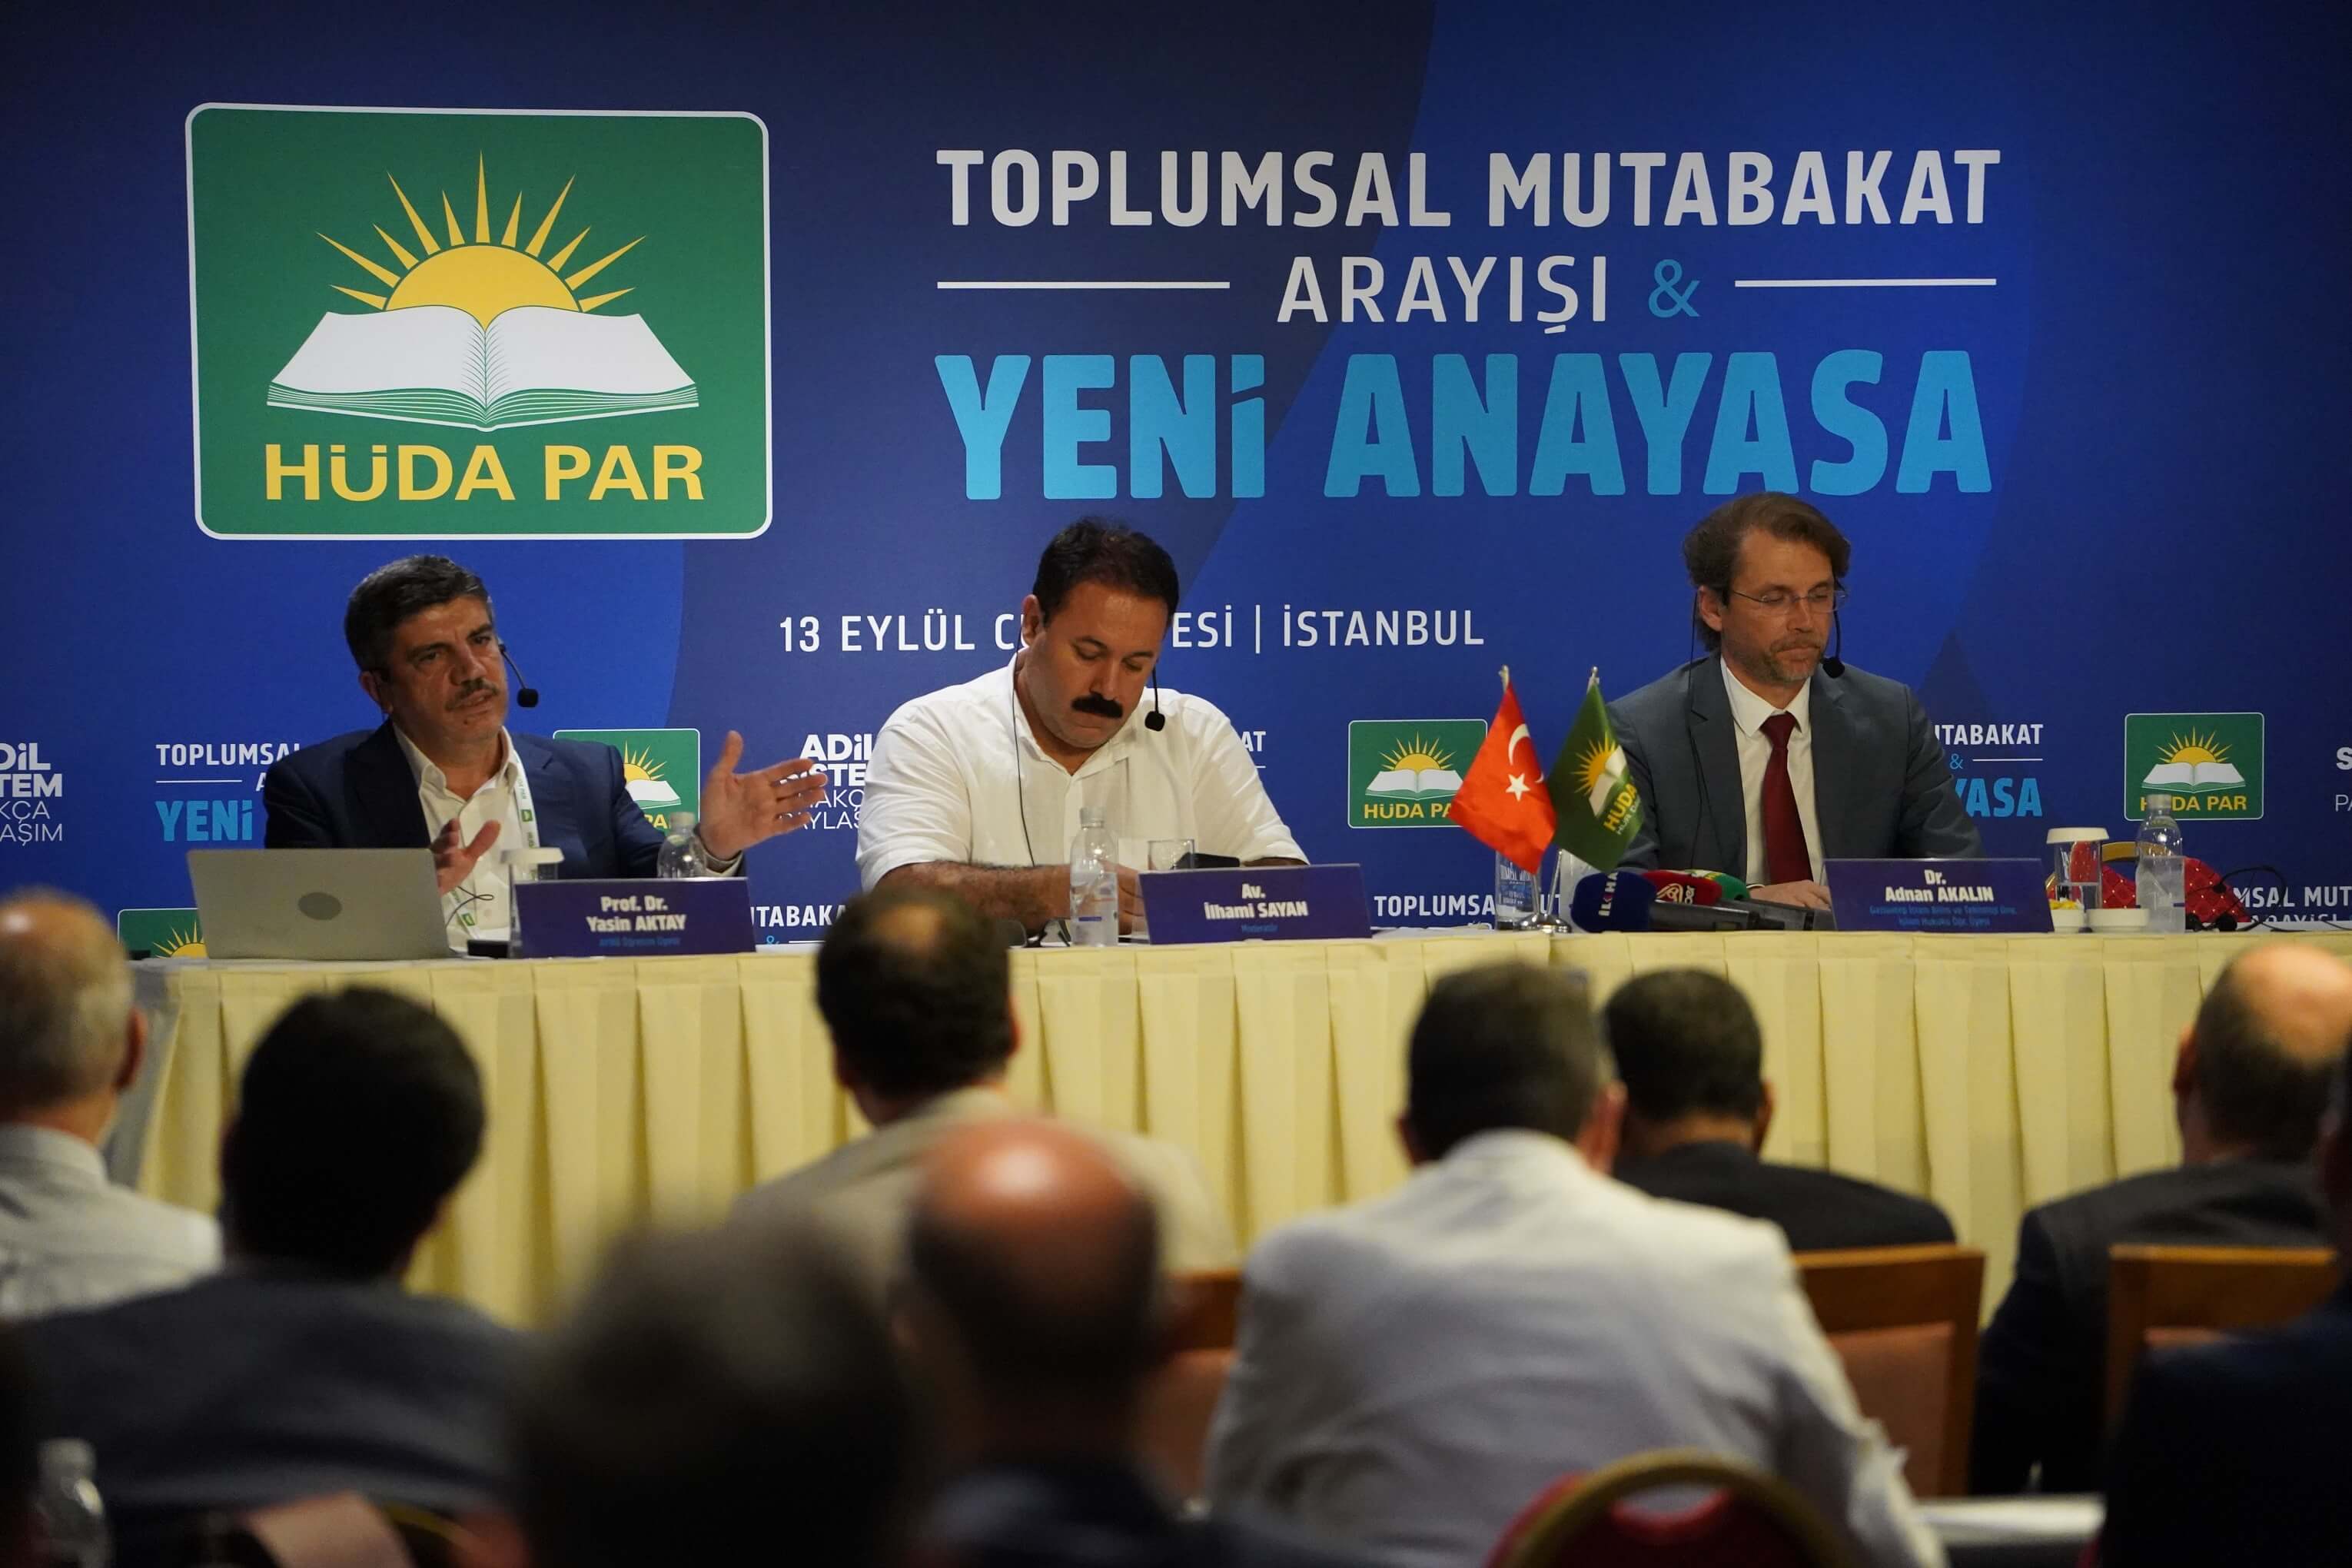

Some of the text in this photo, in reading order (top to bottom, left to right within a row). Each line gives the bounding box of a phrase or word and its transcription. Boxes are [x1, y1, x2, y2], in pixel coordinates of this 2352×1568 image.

[936, 149, 2001, 228] TOPLUMSAL MUTABAKAT
[1277, 255, 1700, 334] ARAYIŞI &
[1324, 350, 1992, 498] ANAYASA
[265, 444, 705, 502] HÜDA PAR
[779, 616, 820, 653] 13
[841, 608, 975, 652] EYLÜL
[1284, 604, 1484, 647] İSTANBUL
[1934, 724, 2044, 746] TABAKAT
[2207, 796, 2247, 811] PAR
[0, 824, 62, 846] AŞIM
[1924, 869, 1947, 885] Dr.
[1241, 883, 1266, 899] Av.
[1885, 886, 1995, 902] Adnan AKALIN
[600, 895, 669, 912] Prof. Dr.
[1257, 901, 1309, 919] SAYAN
[1374, 895, 1496, 916] TOPLUMSA
[586, 914, 686, 932] Yasin AKTAY
